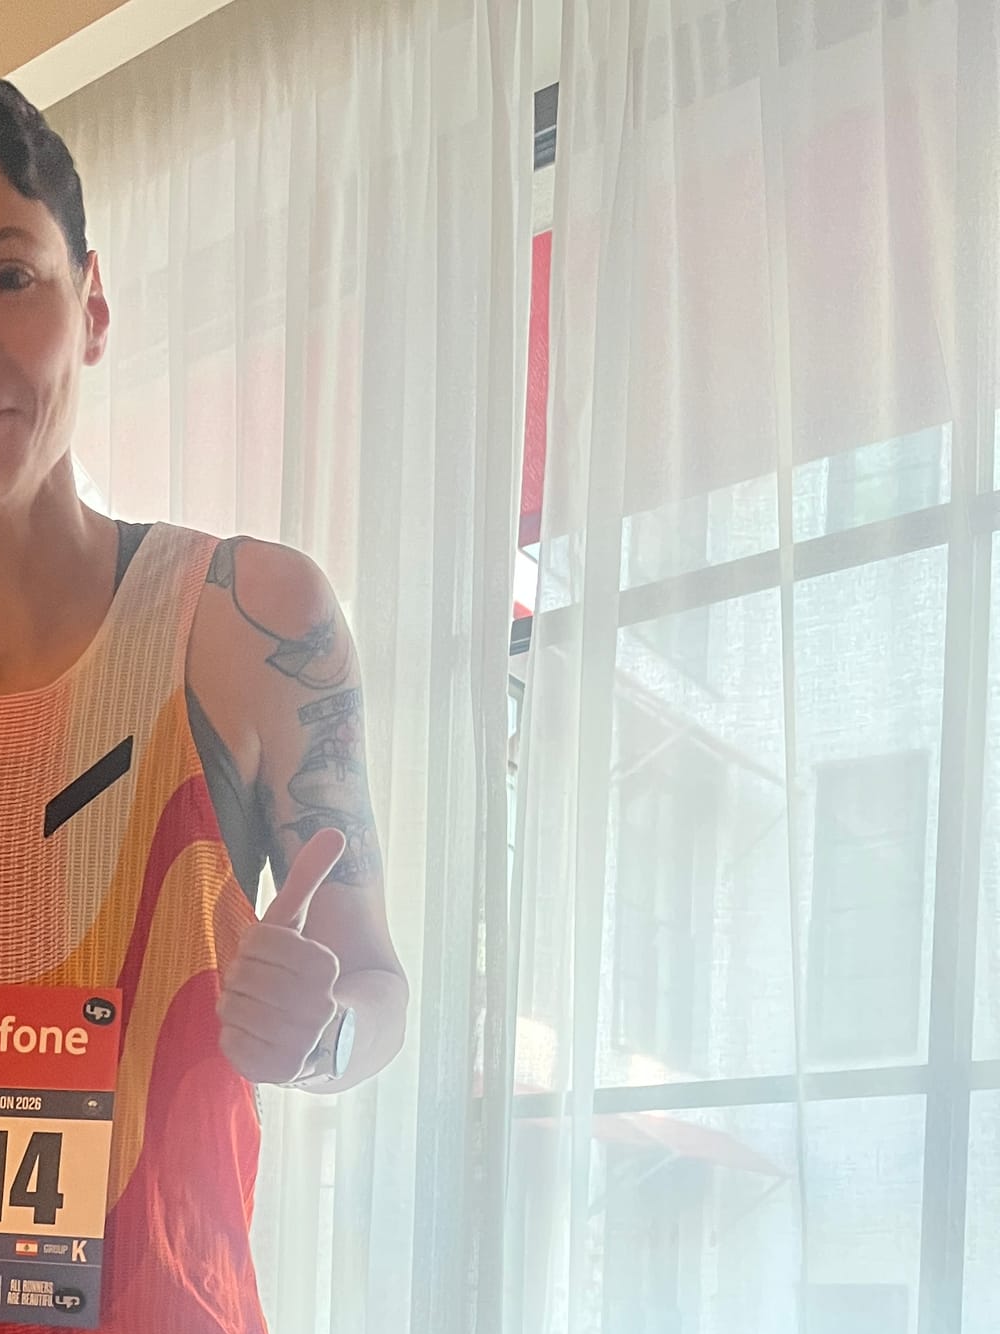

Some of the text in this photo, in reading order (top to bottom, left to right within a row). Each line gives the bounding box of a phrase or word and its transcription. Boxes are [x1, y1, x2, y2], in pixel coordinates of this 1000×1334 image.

[16, 1096, 42, 1111] 2026
[72, 1240, 87, 1262] K
[10, 1279, 53, 1293] ALL RUNNERS
[7, 1292, 19, 1304] ARE
